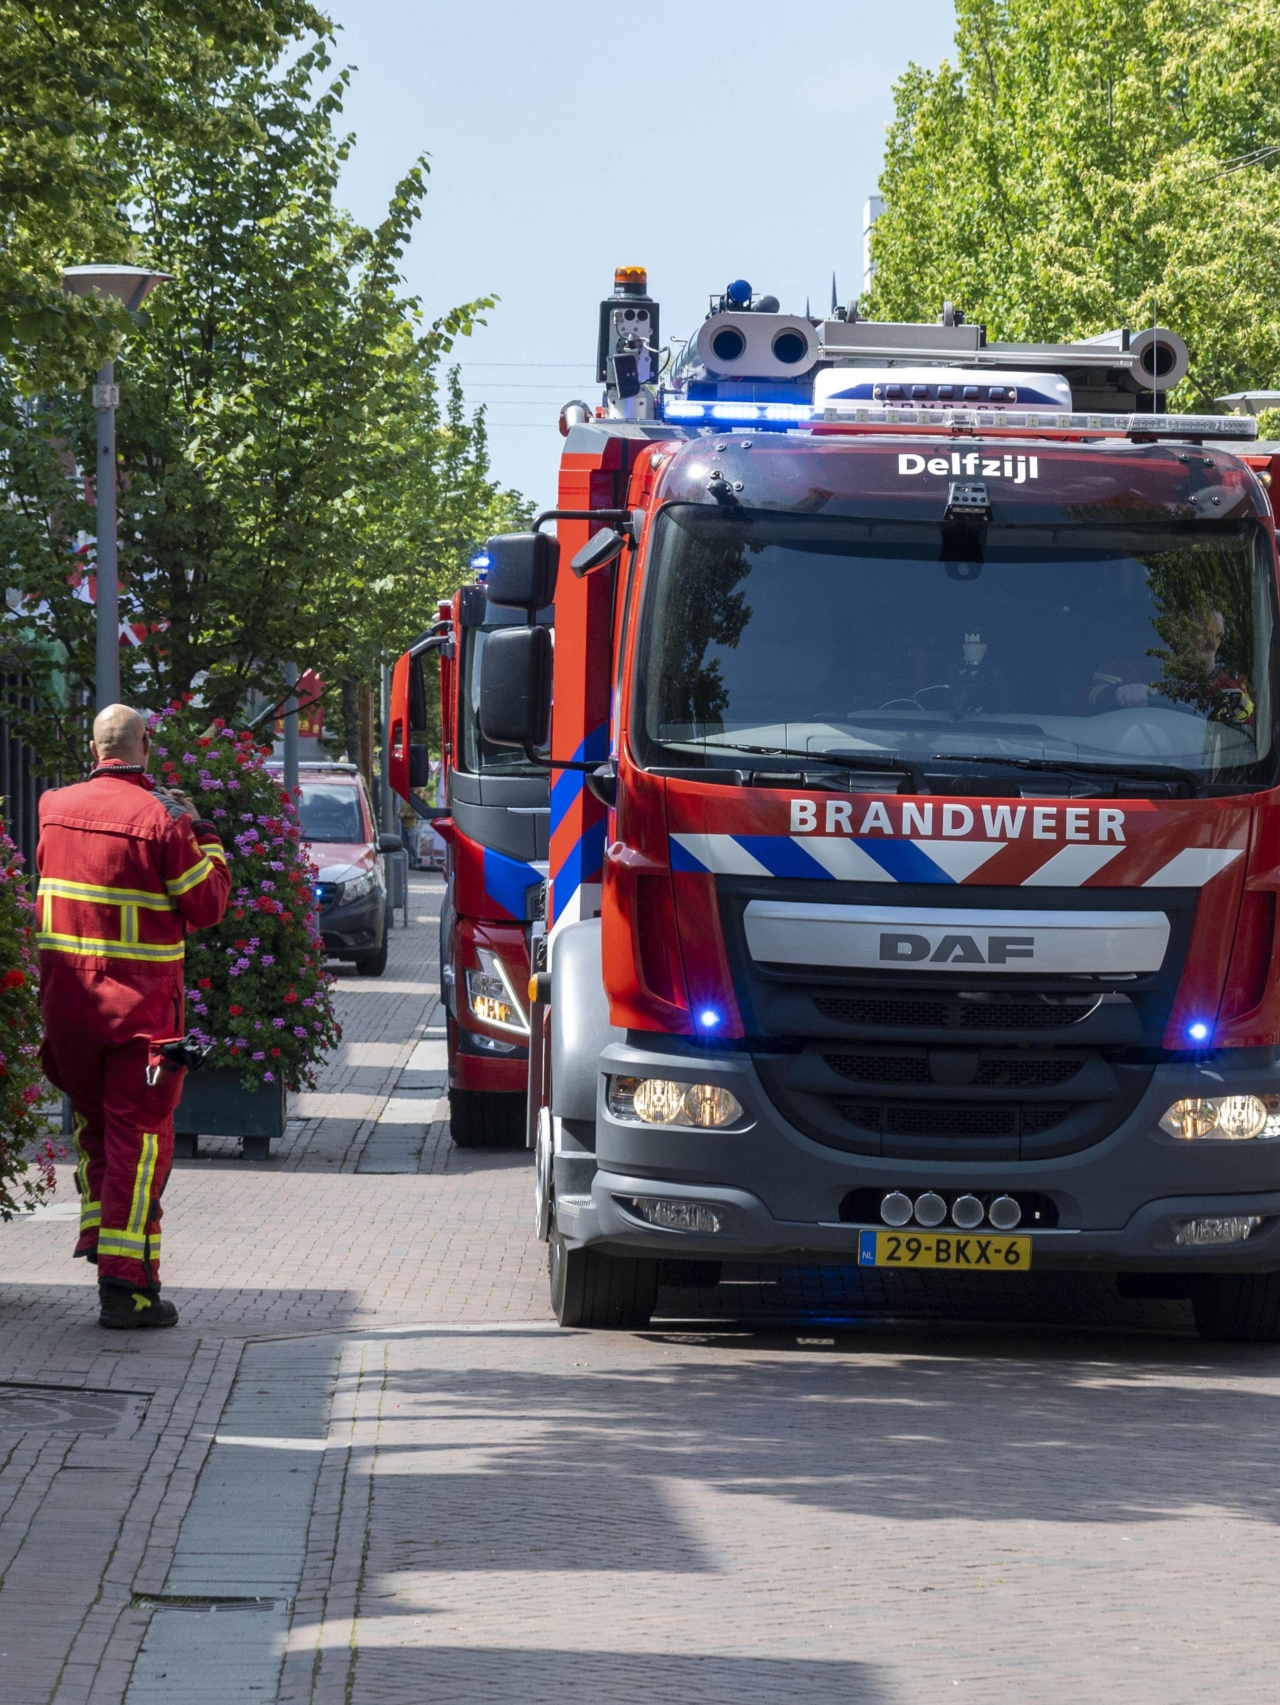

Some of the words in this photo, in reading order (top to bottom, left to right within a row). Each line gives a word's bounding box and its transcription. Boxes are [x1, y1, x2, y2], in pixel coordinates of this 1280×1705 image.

[898, 453, 1038, 484] Delfzijl
[790, 798, 1126, 842] BRANDWEER
[879, 933, 1035, 964] DAF
[863, 1251, 873, 1260] NL
[886, 1236, 1021, 1265] 29-BKX-6
